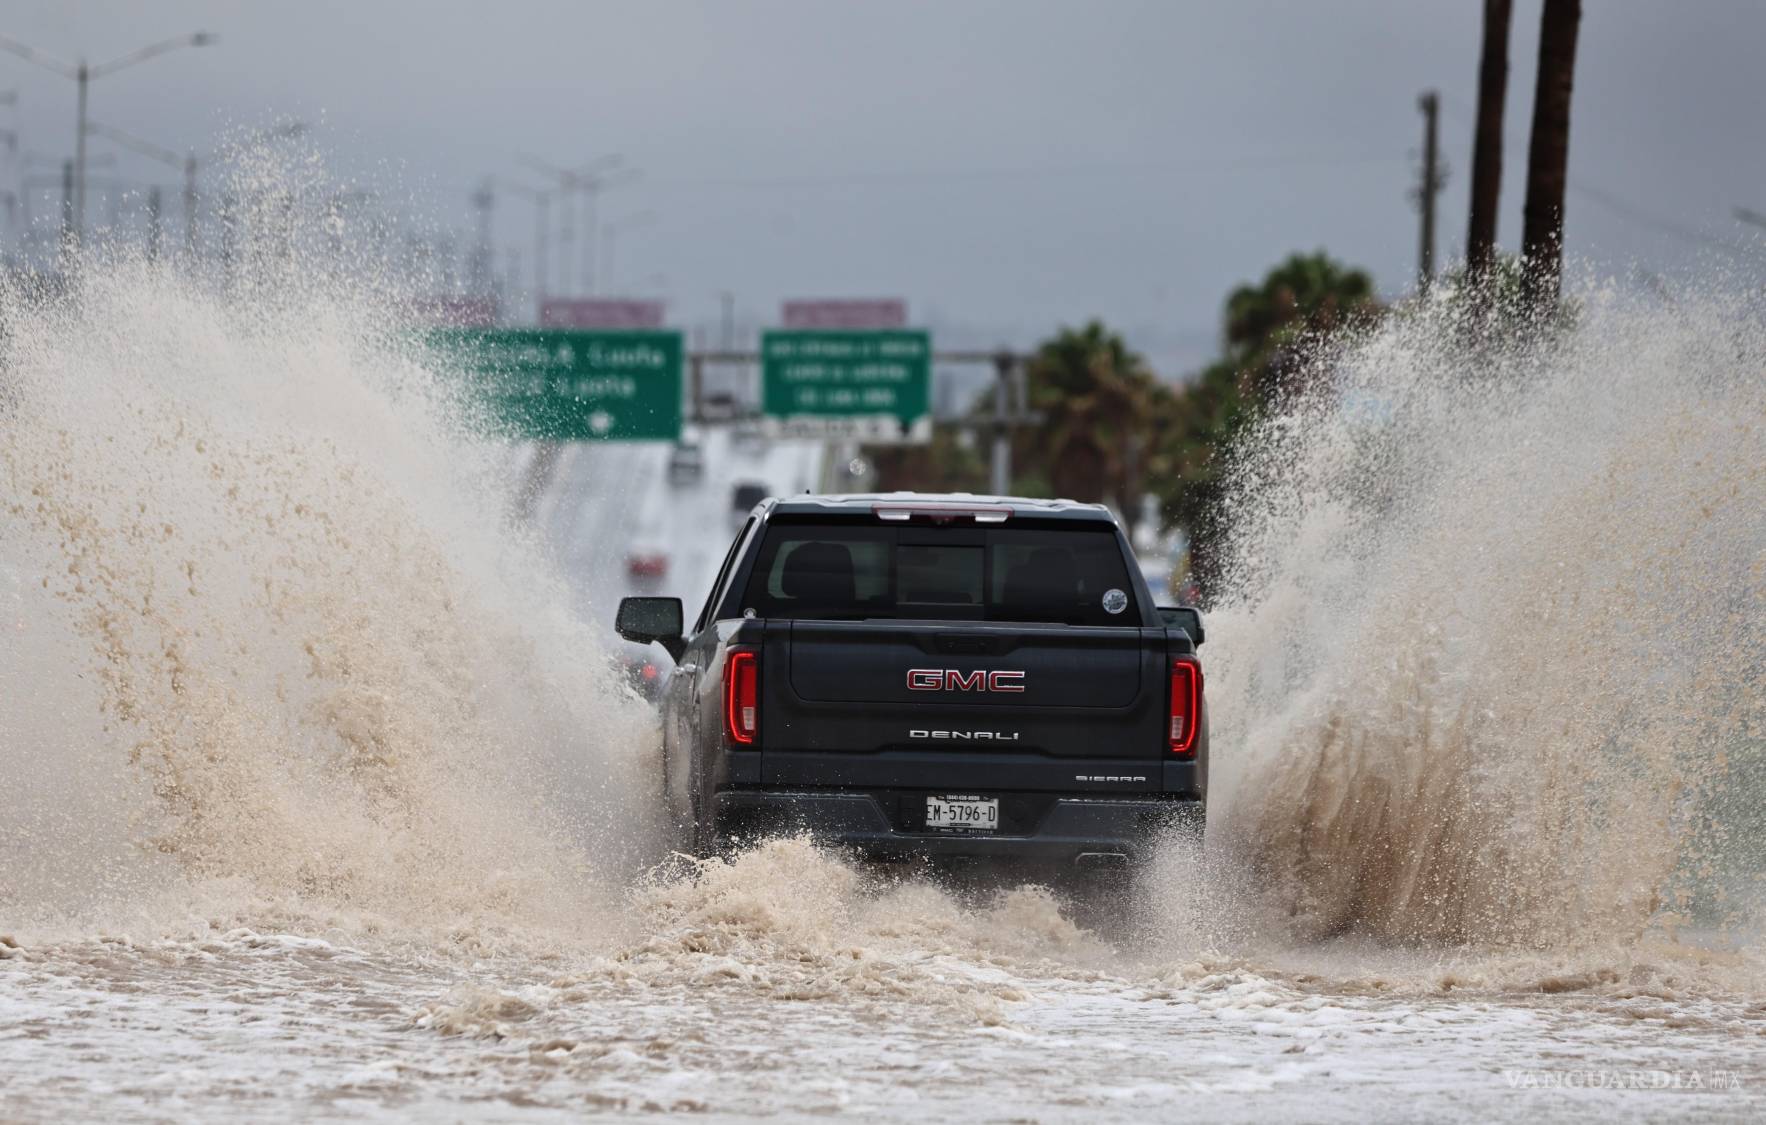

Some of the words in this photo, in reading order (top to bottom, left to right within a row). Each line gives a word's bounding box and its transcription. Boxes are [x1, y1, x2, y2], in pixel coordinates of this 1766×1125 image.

[906, 668, 1026, 692] GMC
[909, 729, 1019, 740] DENALI
[926, 804, 996, 822] EM-5796-D
